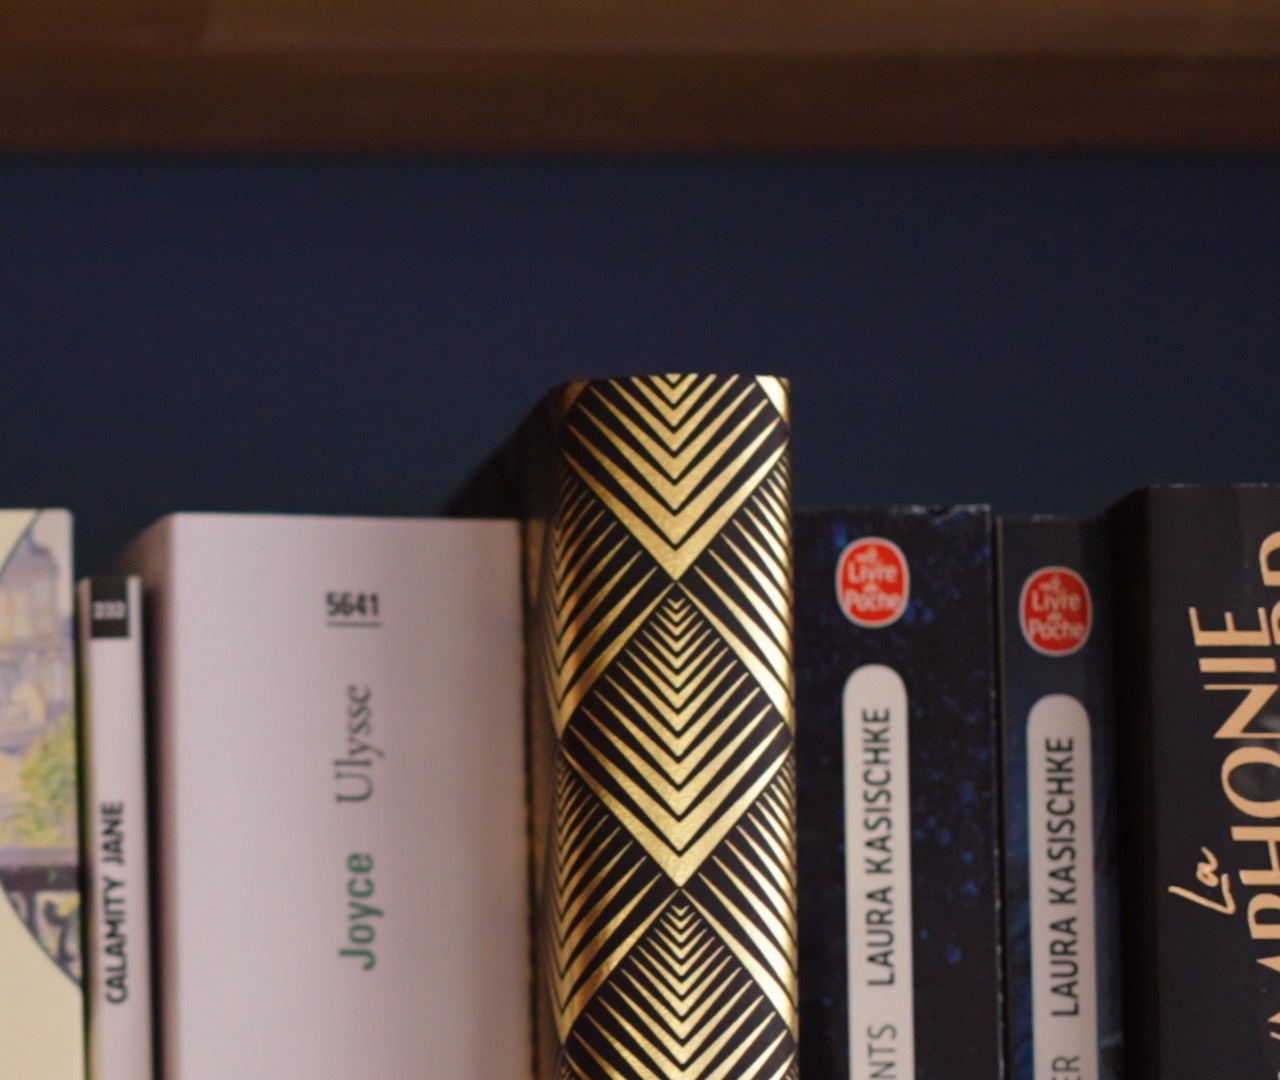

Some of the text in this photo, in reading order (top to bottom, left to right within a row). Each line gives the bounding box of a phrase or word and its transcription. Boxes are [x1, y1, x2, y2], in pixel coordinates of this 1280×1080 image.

[325, 591, 380, 617] 5641
[101, 801, 128, 1005] CALAMITY JANE
[333, 684, 385, 972] Joyce Ulysse
[863, 708, 895, 987] LAURA KASISCHKE
[1046, 737, 1079, 1017] LAURA KASISCHKE
[1168, 846, 1236, 914] La
